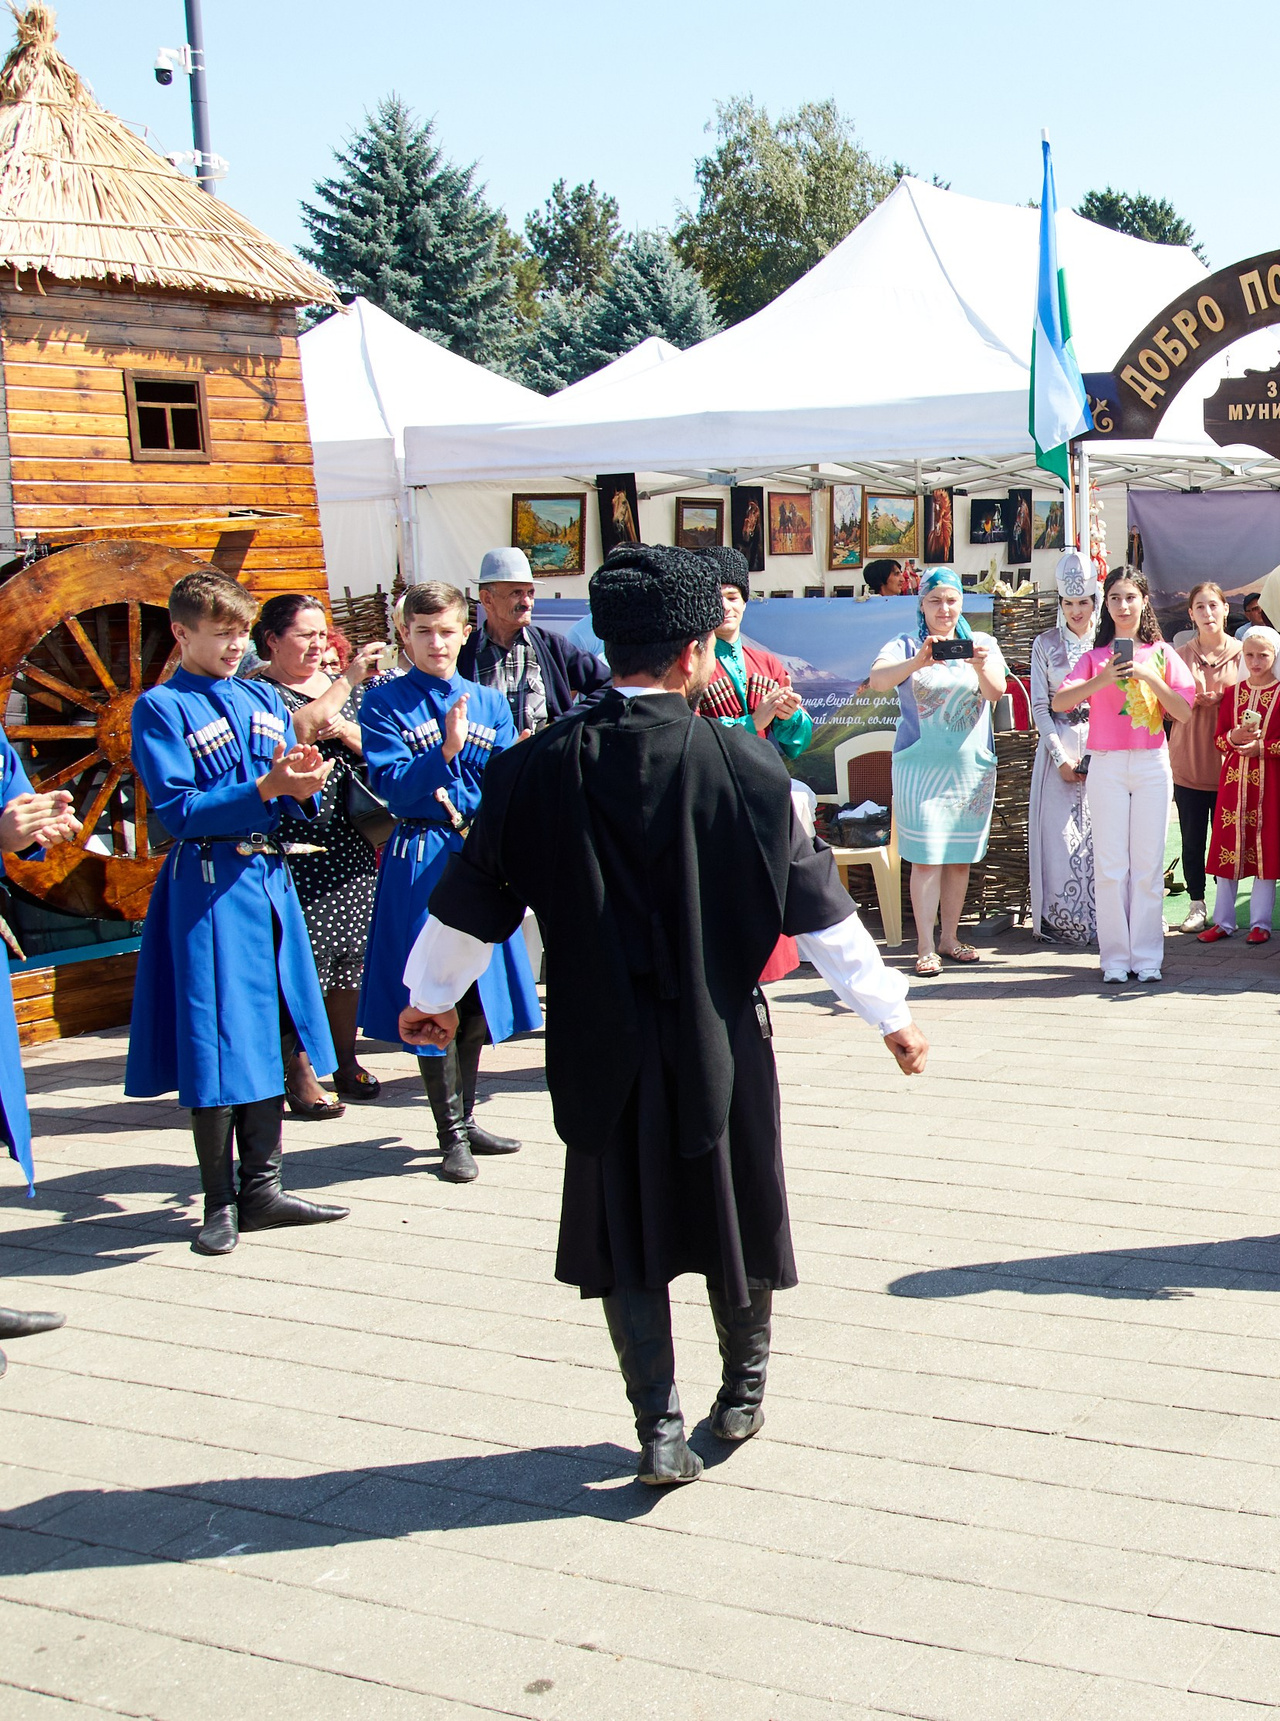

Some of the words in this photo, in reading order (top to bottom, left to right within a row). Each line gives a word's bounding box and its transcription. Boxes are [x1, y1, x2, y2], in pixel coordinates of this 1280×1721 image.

[1120, 295, 1225, 409] ДОБРО
[855, 697, 872, 706] на
[872, 696, 899, 709] долг
[812, 712, 828, 725] ай
